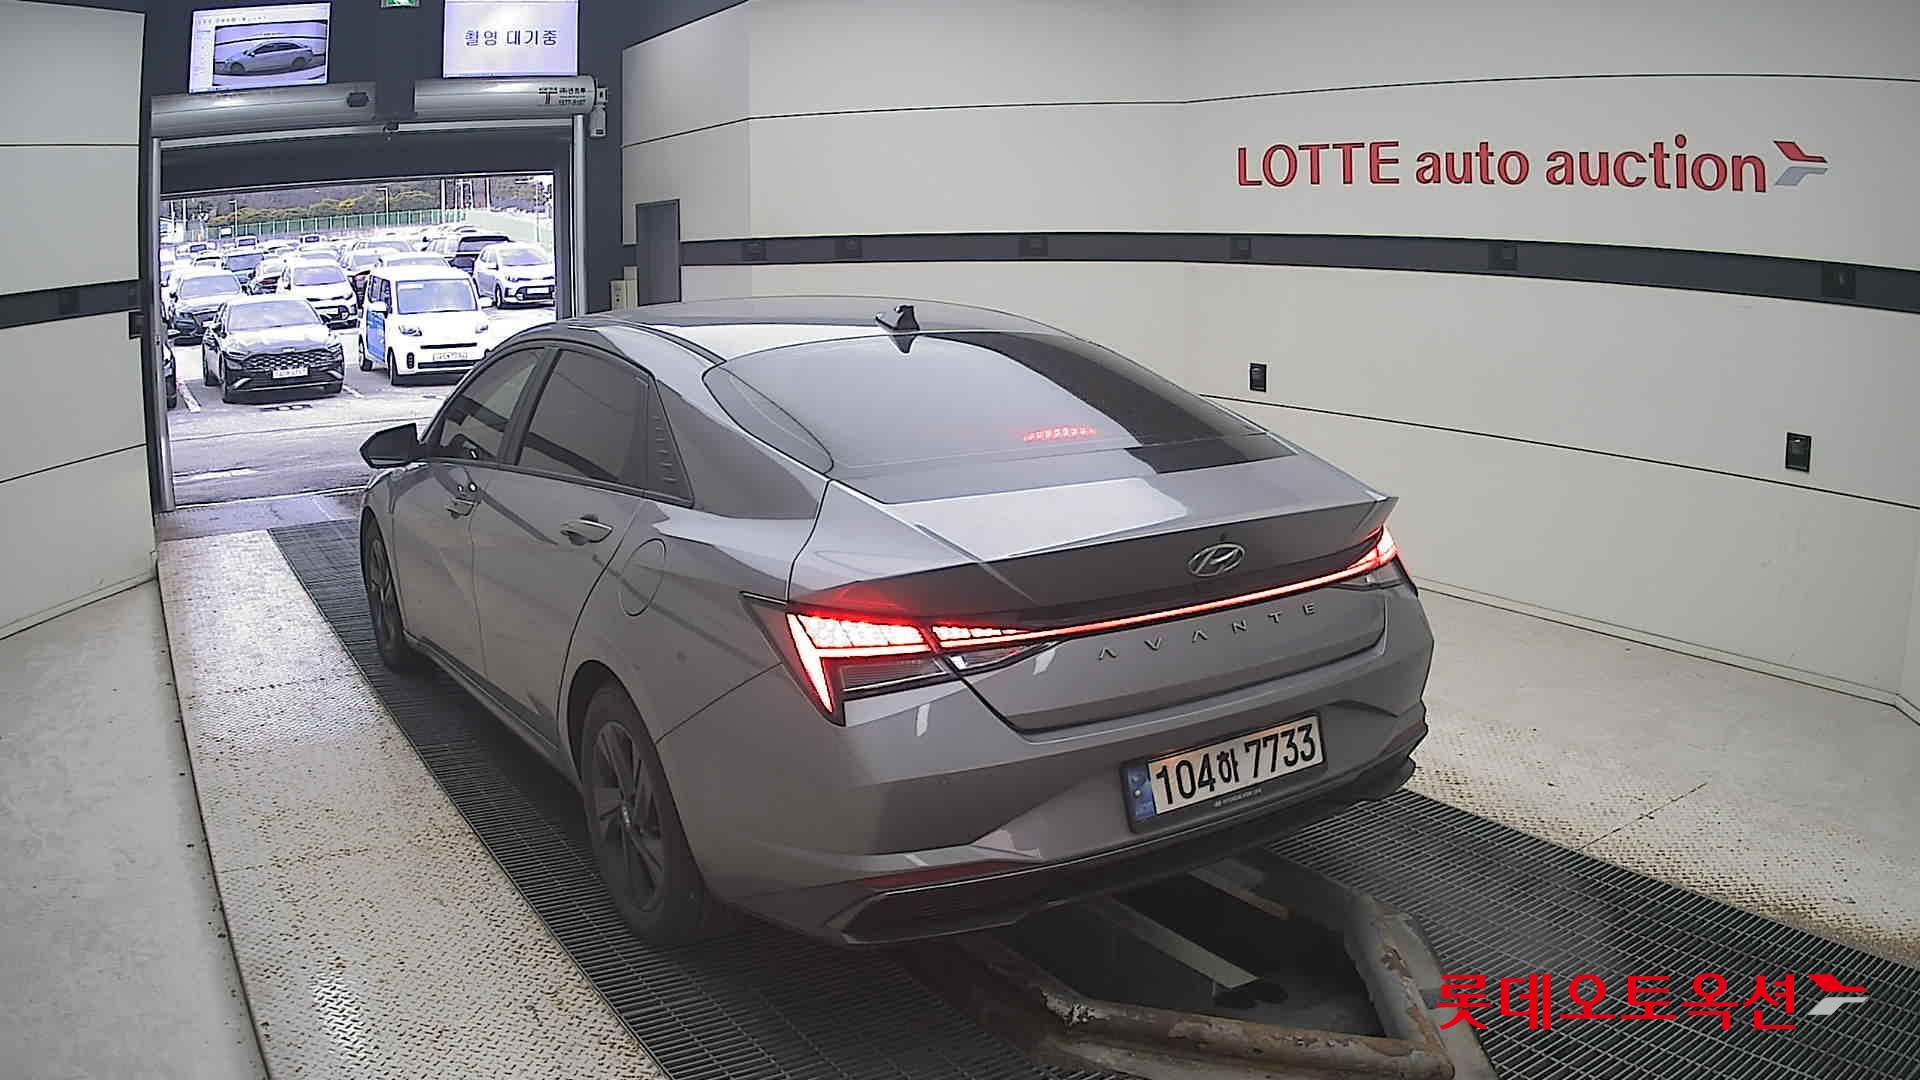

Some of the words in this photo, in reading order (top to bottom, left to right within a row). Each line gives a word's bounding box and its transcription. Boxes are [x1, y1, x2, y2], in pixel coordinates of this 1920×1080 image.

[506, 29, 558, 47] 대기중
[1237, 141, 1400, 187] LOTTE
[1415, 142, 1530, 186] auto
[1545, 134, 1767, 193] auction
[1098, 601, 1316, 660] AVANTE
